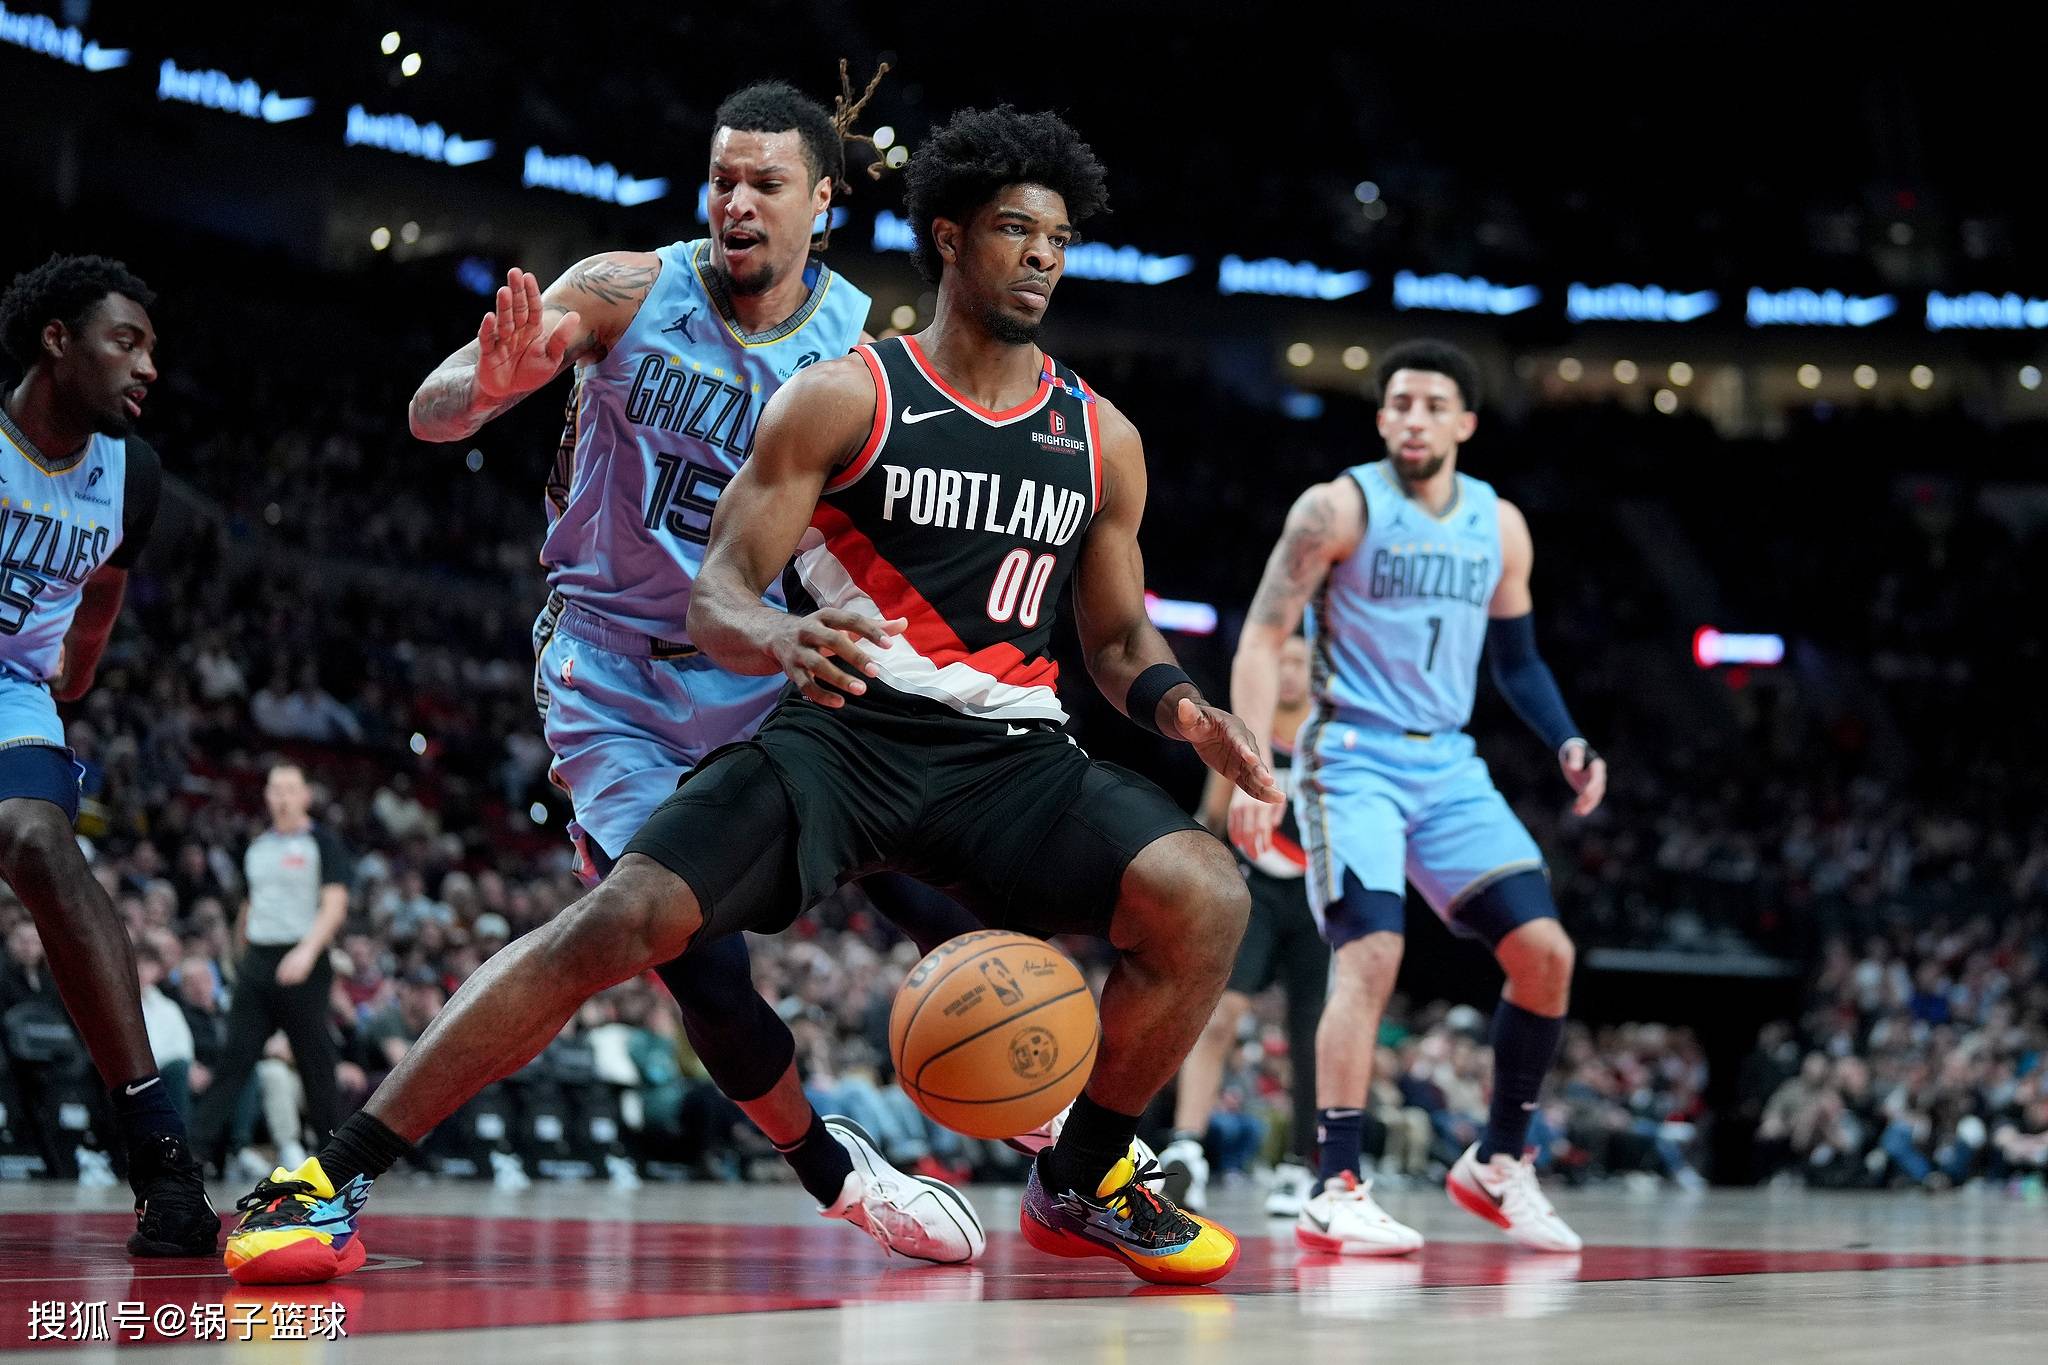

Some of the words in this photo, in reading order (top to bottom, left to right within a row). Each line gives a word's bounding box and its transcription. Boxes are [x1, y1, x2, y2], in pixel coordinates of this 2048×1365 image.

[1032, 431, 1085, 451] BRIGHTSIDE
[1055, 415, 1063, 431] B
[644, 452, 732, 546] 15
[882, 464, 1086, 547] PORTLAND
[0, 508, 109, 585] IZZLIES
[1370, 549, 1489, 608] GRIZZLIES
[986, 547, 1057, 628] 00
